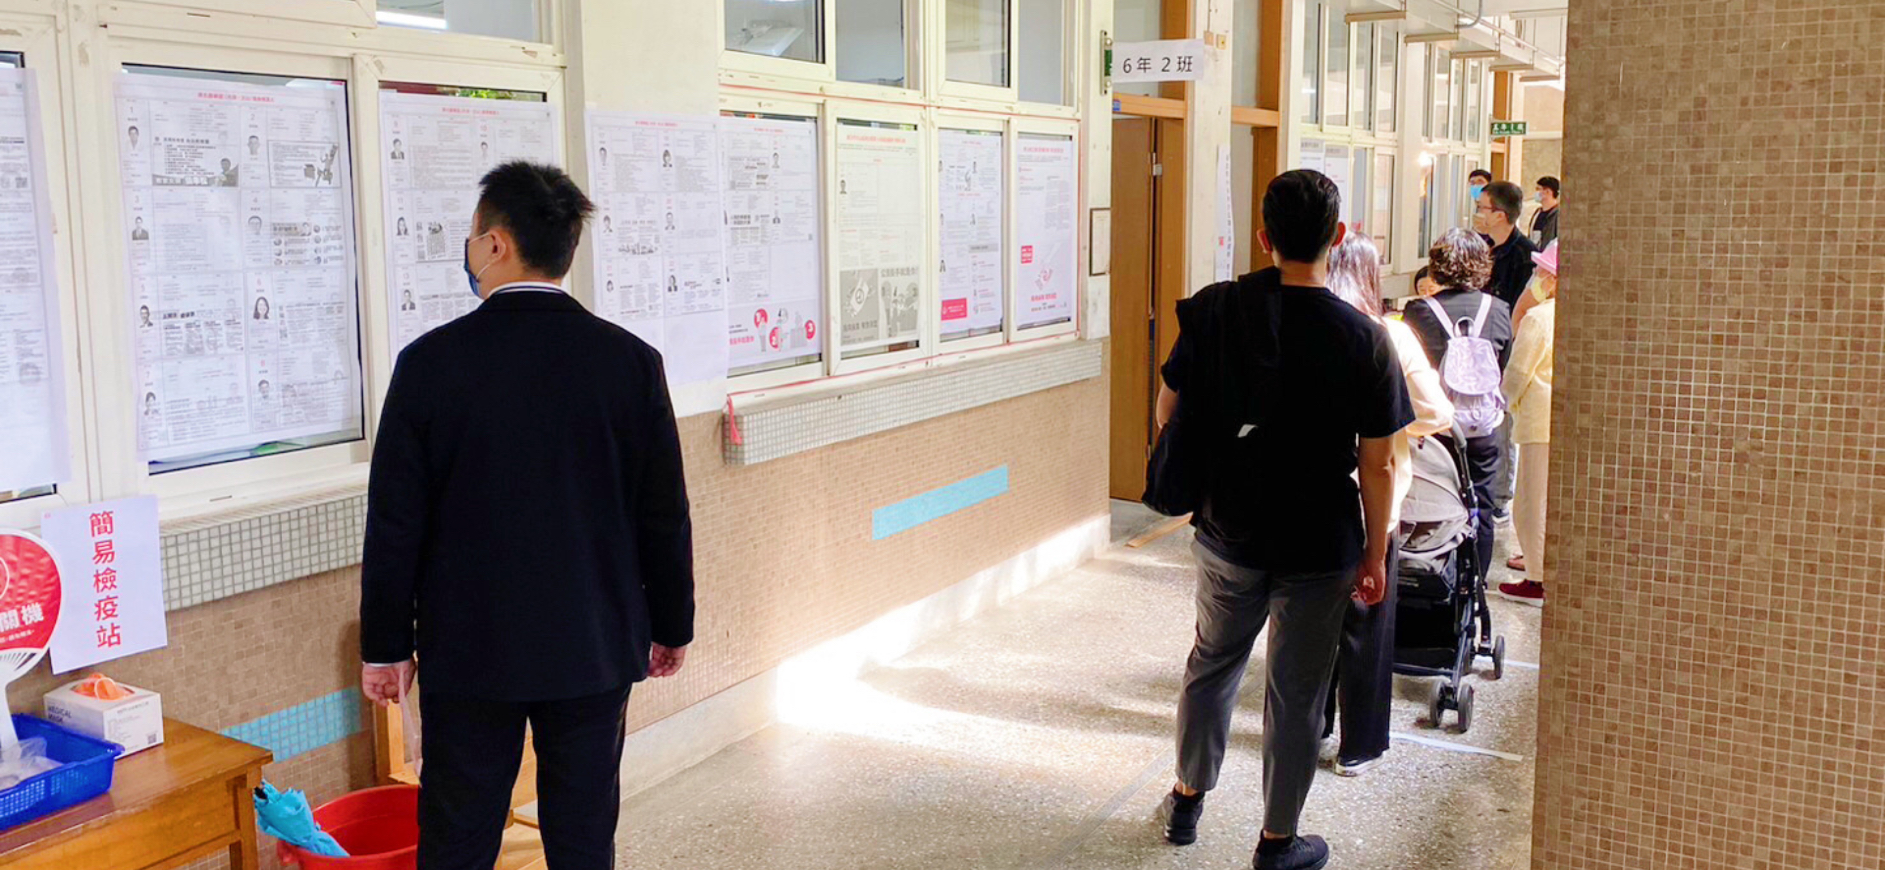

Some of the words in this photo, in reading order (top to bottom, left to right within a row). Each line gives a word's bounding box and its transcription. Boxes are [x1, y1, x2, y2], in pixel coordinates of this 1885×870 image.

[89, 510, 121, 649] 簡易檢疫站
